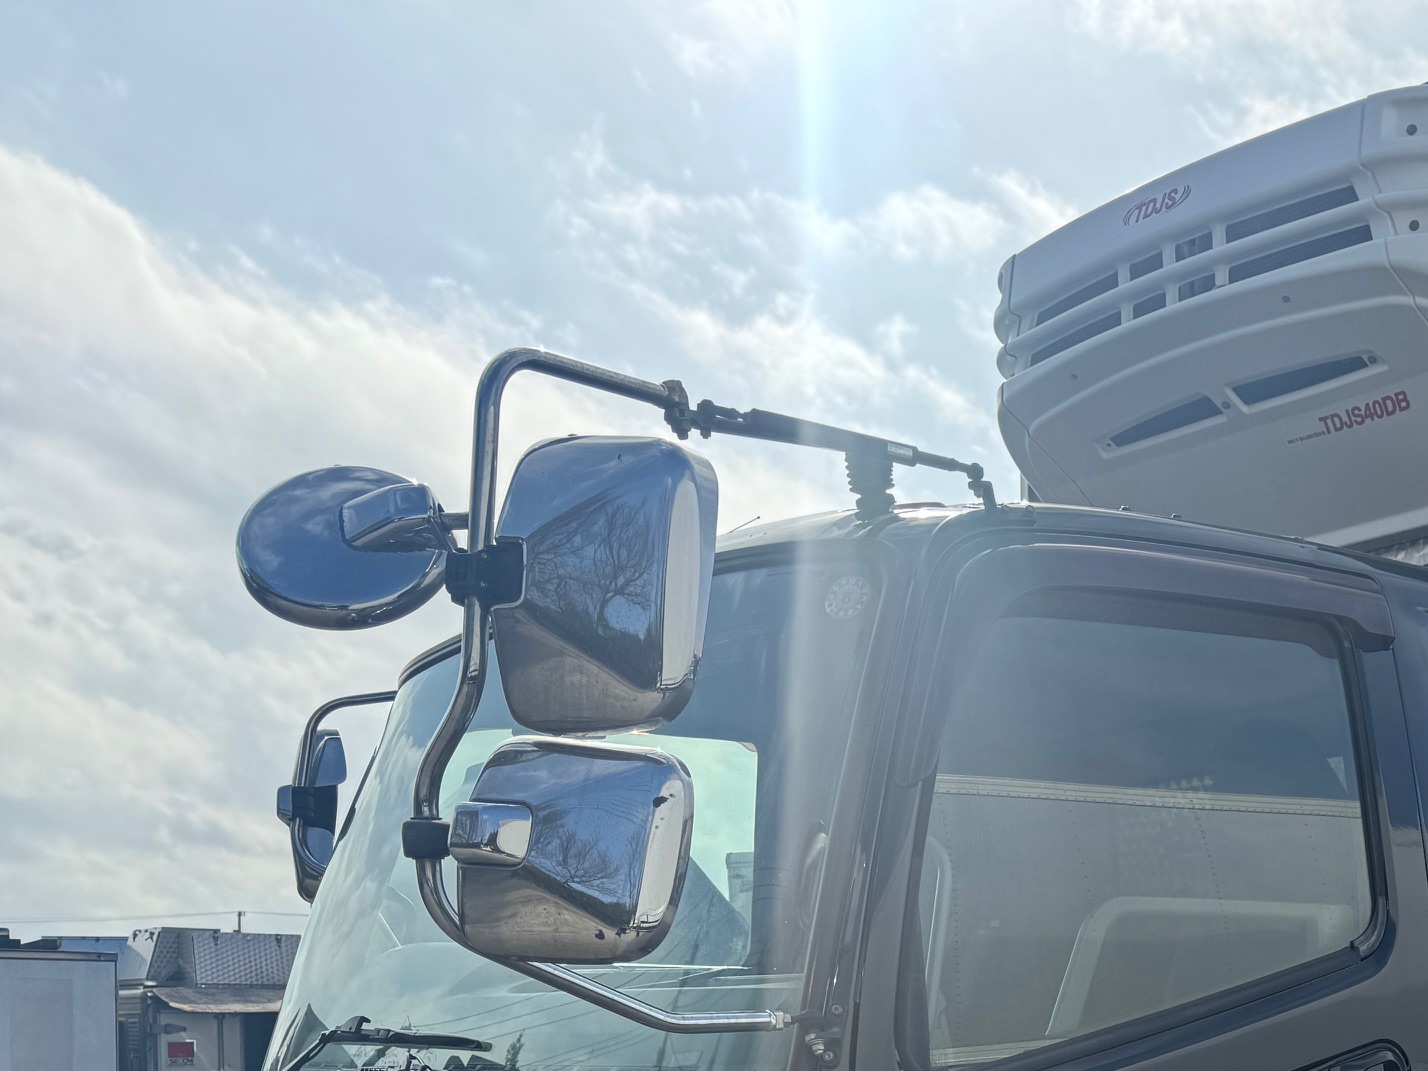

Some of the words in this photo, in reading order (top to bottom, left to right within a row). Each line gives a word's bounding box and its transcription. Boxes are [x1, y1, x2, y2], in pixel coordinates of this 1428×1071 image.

[1134, 187, 1179, 224] TDJS
[1318, 390, 1411, 434] TDJS40DB
[1287, 430, 1326, 445] MITSUBISHI
